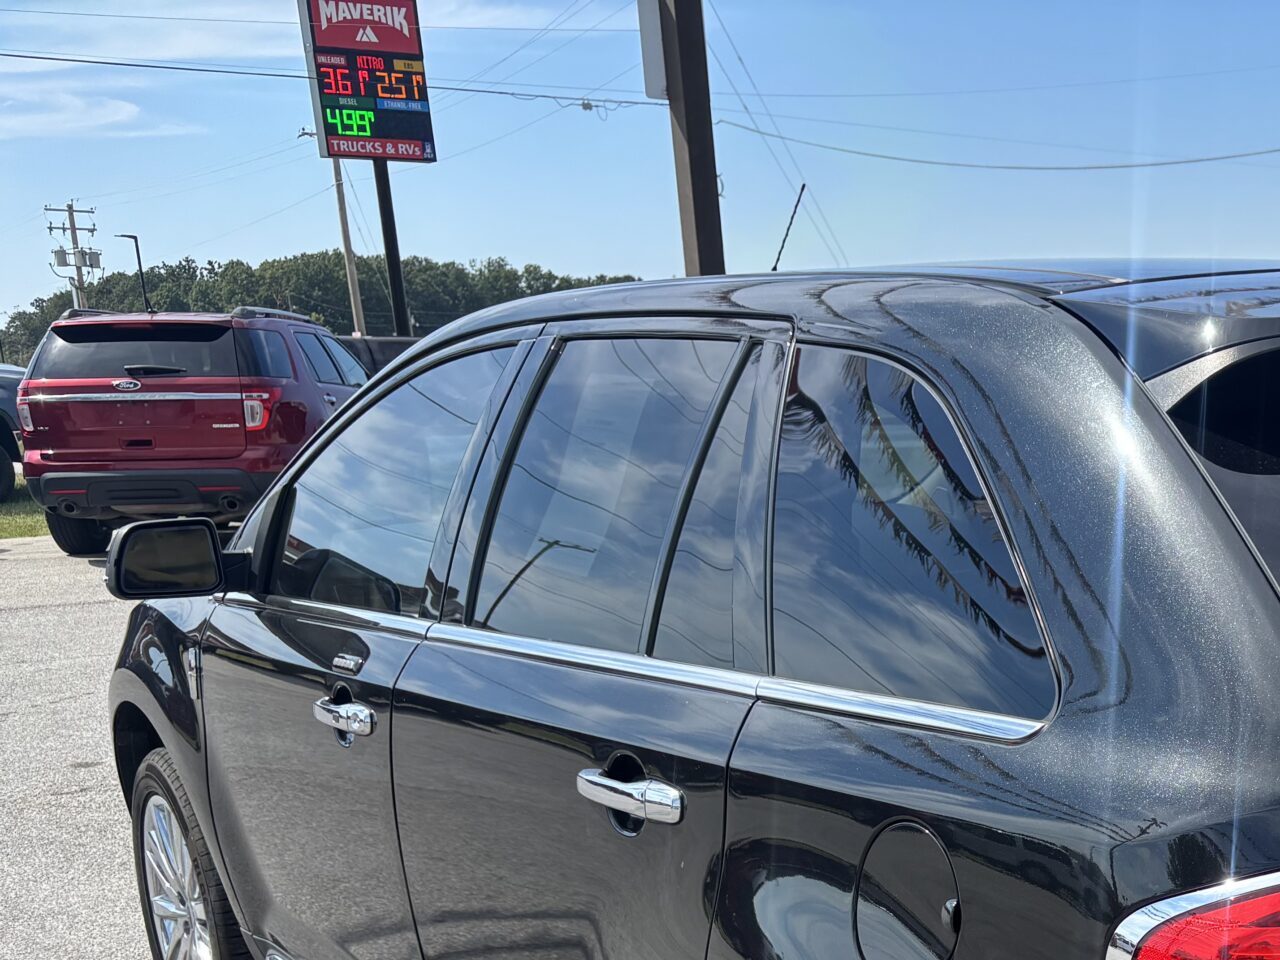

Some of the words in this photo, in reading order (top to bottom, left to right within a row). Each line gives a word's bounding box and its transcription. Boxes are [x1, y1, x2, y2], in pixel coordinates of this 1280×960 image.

[318, 0, 410, 38] MAVERIK
[356, 55, 385, 70] NITRO
[331, 140, 384, 154] TRUCKS
[386, 141, 395, 153] &
[398, 143, 421, 156] RVs
